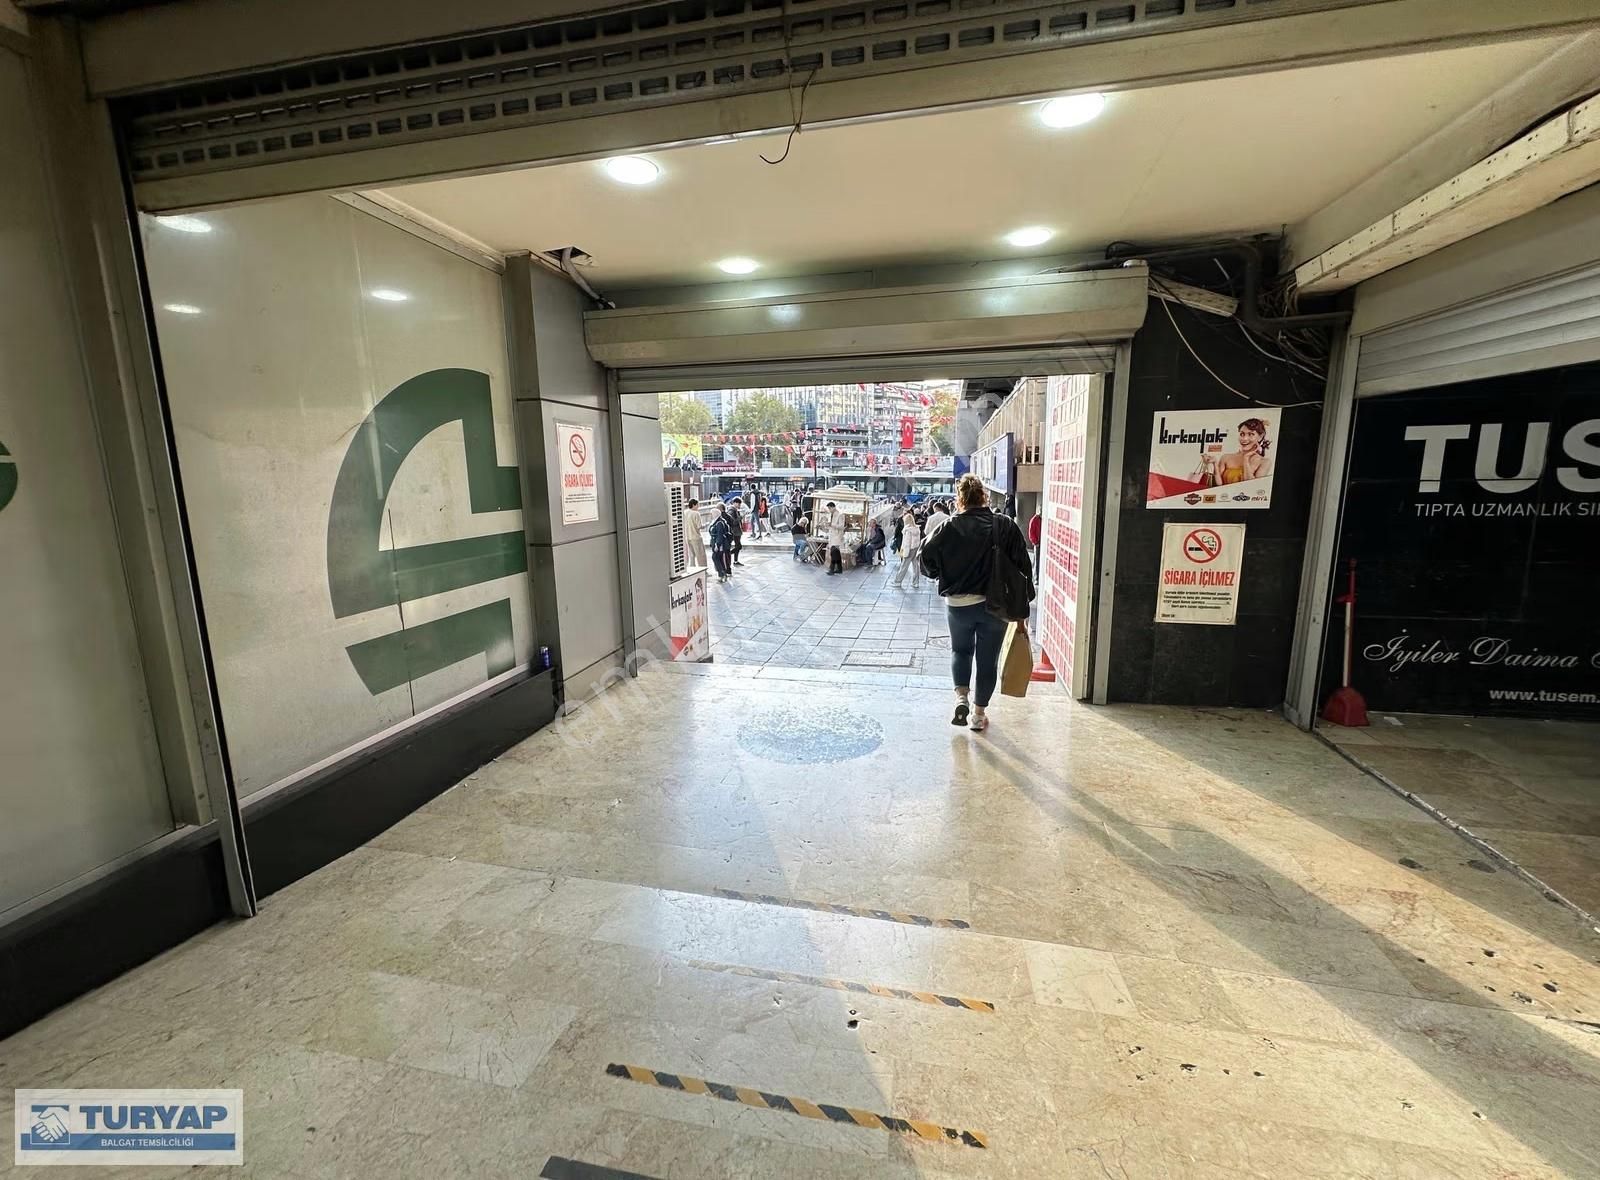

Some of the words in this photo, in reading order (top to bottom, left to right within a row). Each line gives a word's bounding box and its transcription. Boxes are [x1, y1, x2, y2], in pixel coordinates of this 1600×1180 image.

[1414, 503, 1465, 517] TIPTA
[1471, 502, 1573, 517] UZMANLIK
[1577, 502, 1600, 516] SI
[1164, 568, 1196, 585] SİGARA
[1199, 568, 1235, 588] İÇİLMEZ
[1363, 628, 1460, 673] İyiler
[1469, 636, 1579, 668] Daima
